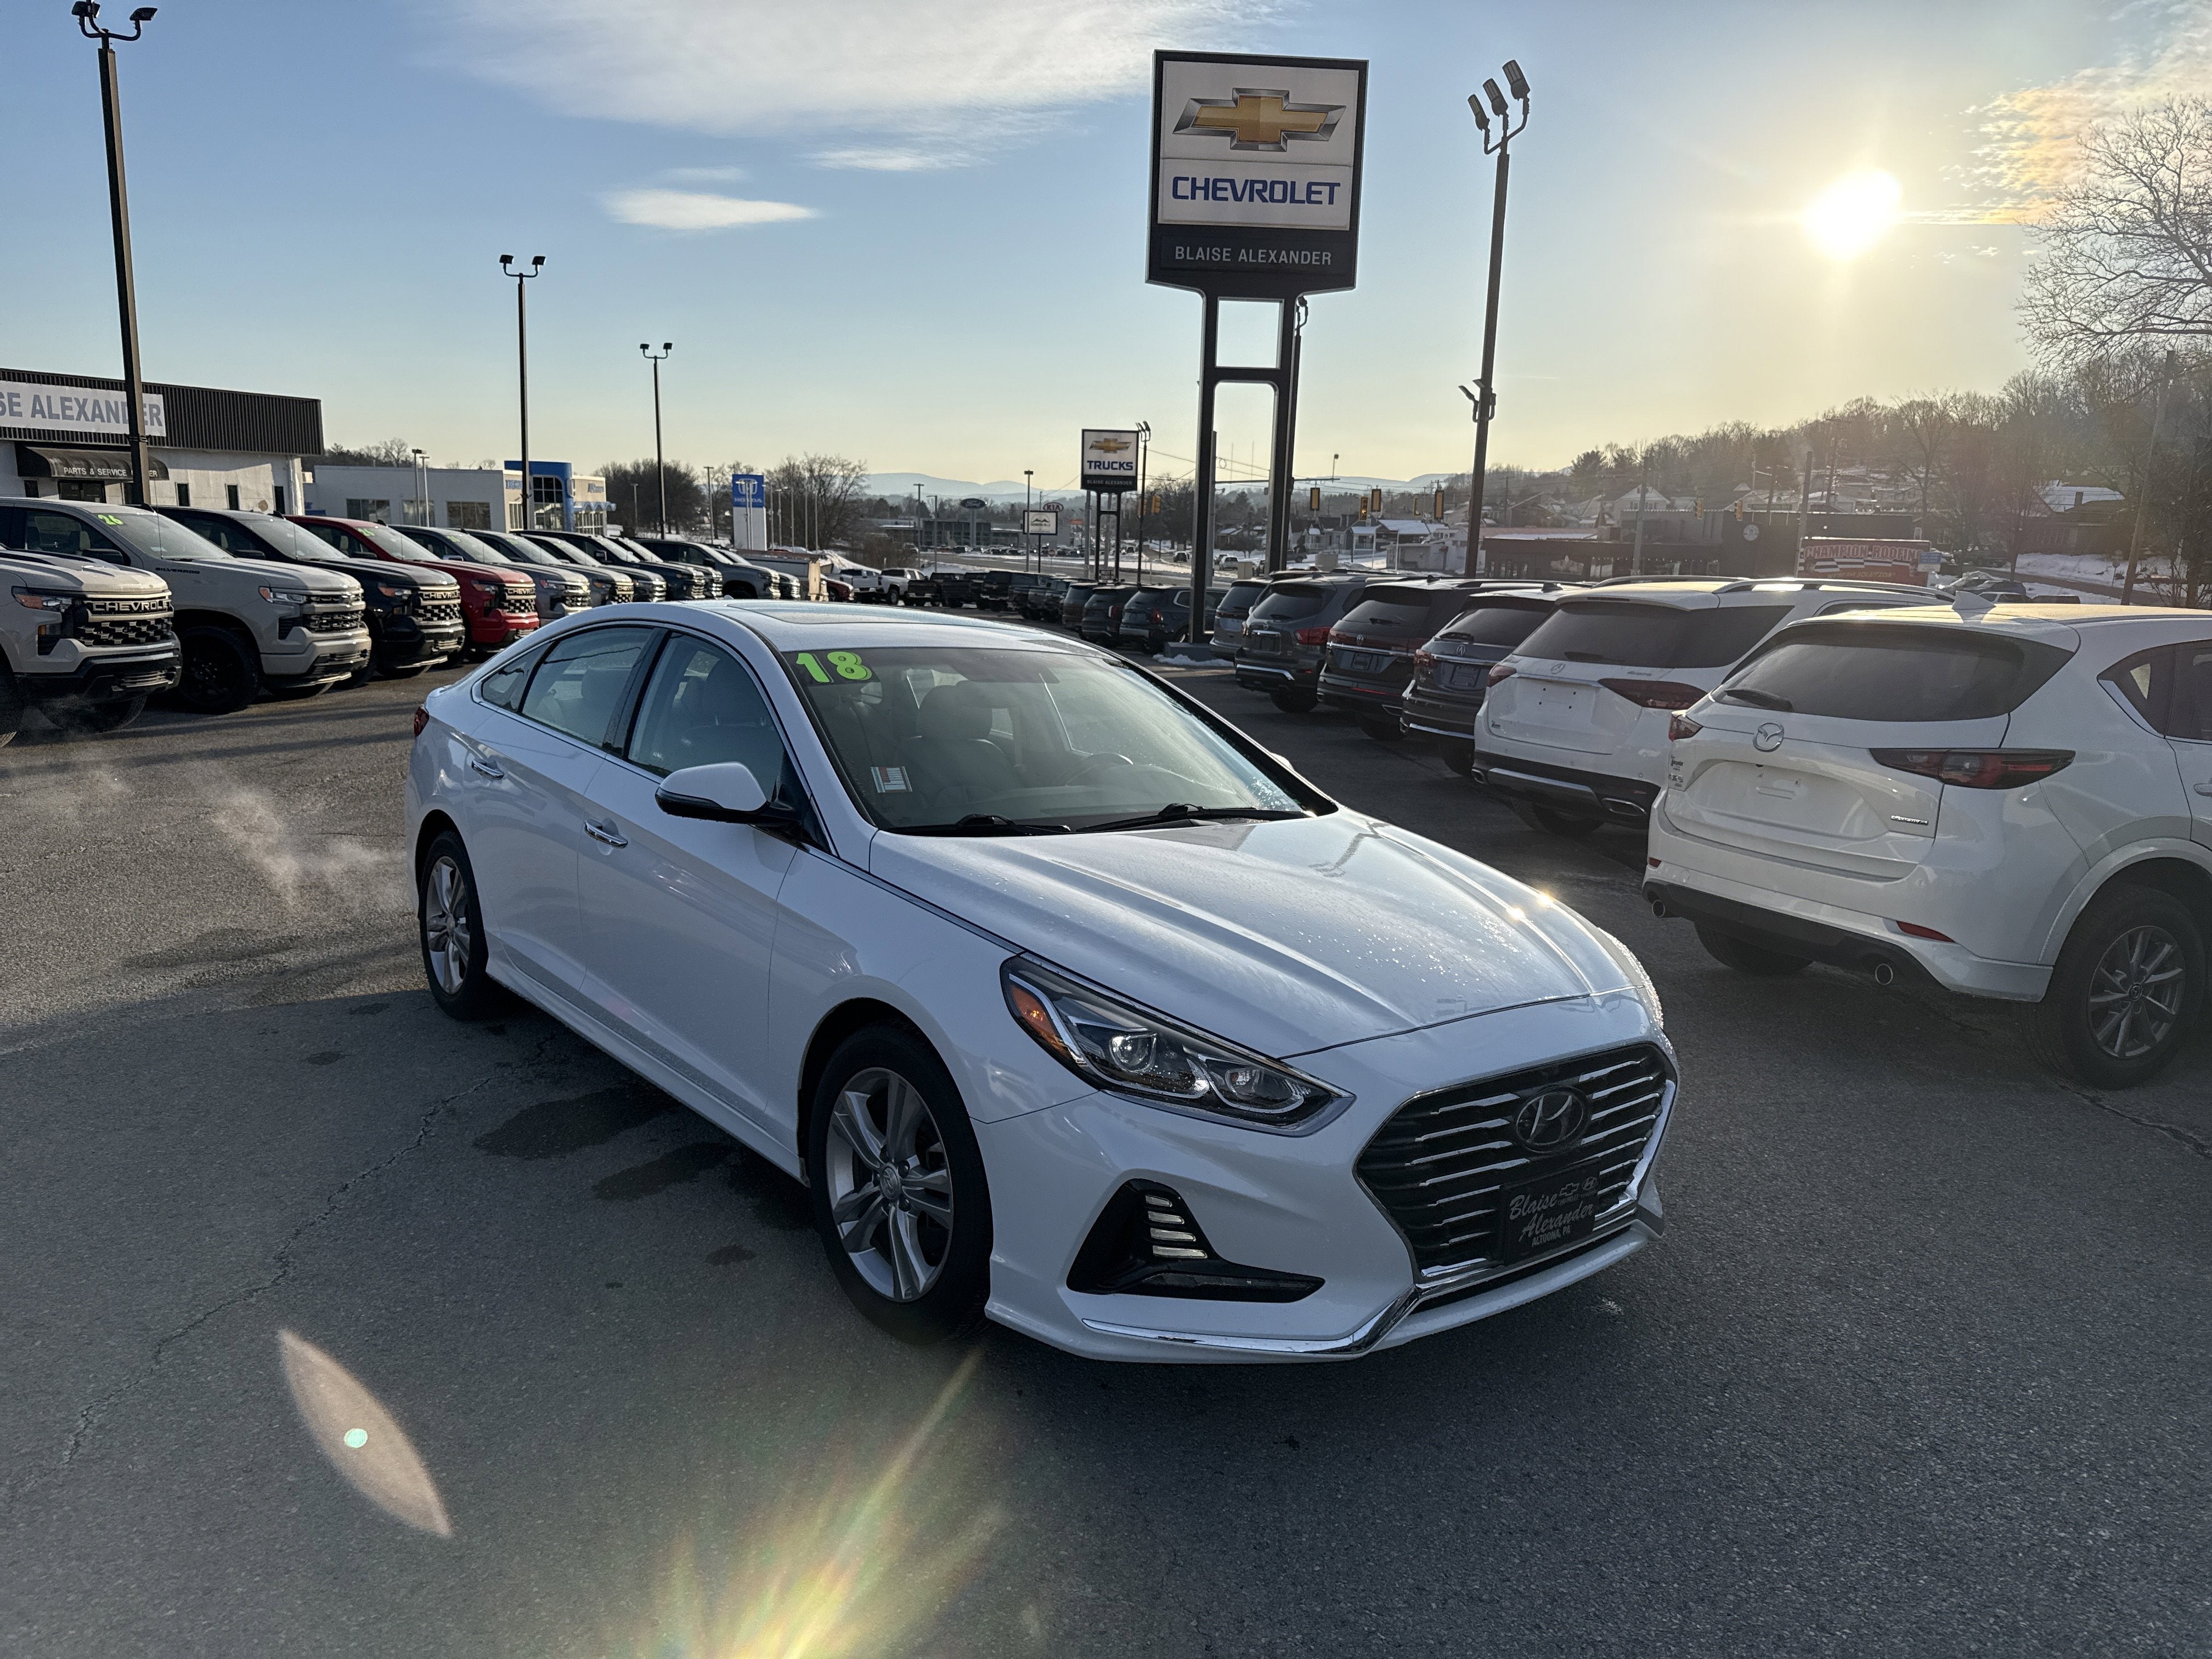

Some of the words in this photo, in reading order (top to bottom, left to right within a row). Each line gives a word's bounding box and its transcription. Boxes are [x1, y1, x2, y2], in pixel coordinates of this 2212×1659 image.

[1172, 176, 1340, 205] CHEVROLET
[1175, 246, 1232, 262] BLAISE
[1238, 248, 1331, 266] ALEXANDER
[64, 467, 87, 475] PARTS
[97, 468, 127, 477] SERVICE
[1087, 460, 1133, 471] TRUCKS
[98, 515, 124, 526] 26
[1803, 544, 1869, 560] CHAMPION
[796, 651, 872, 683] 18
[1509, 1194, 1558, 1220] Blaise
[1518, 1200, 1595, 1243] Alexander
